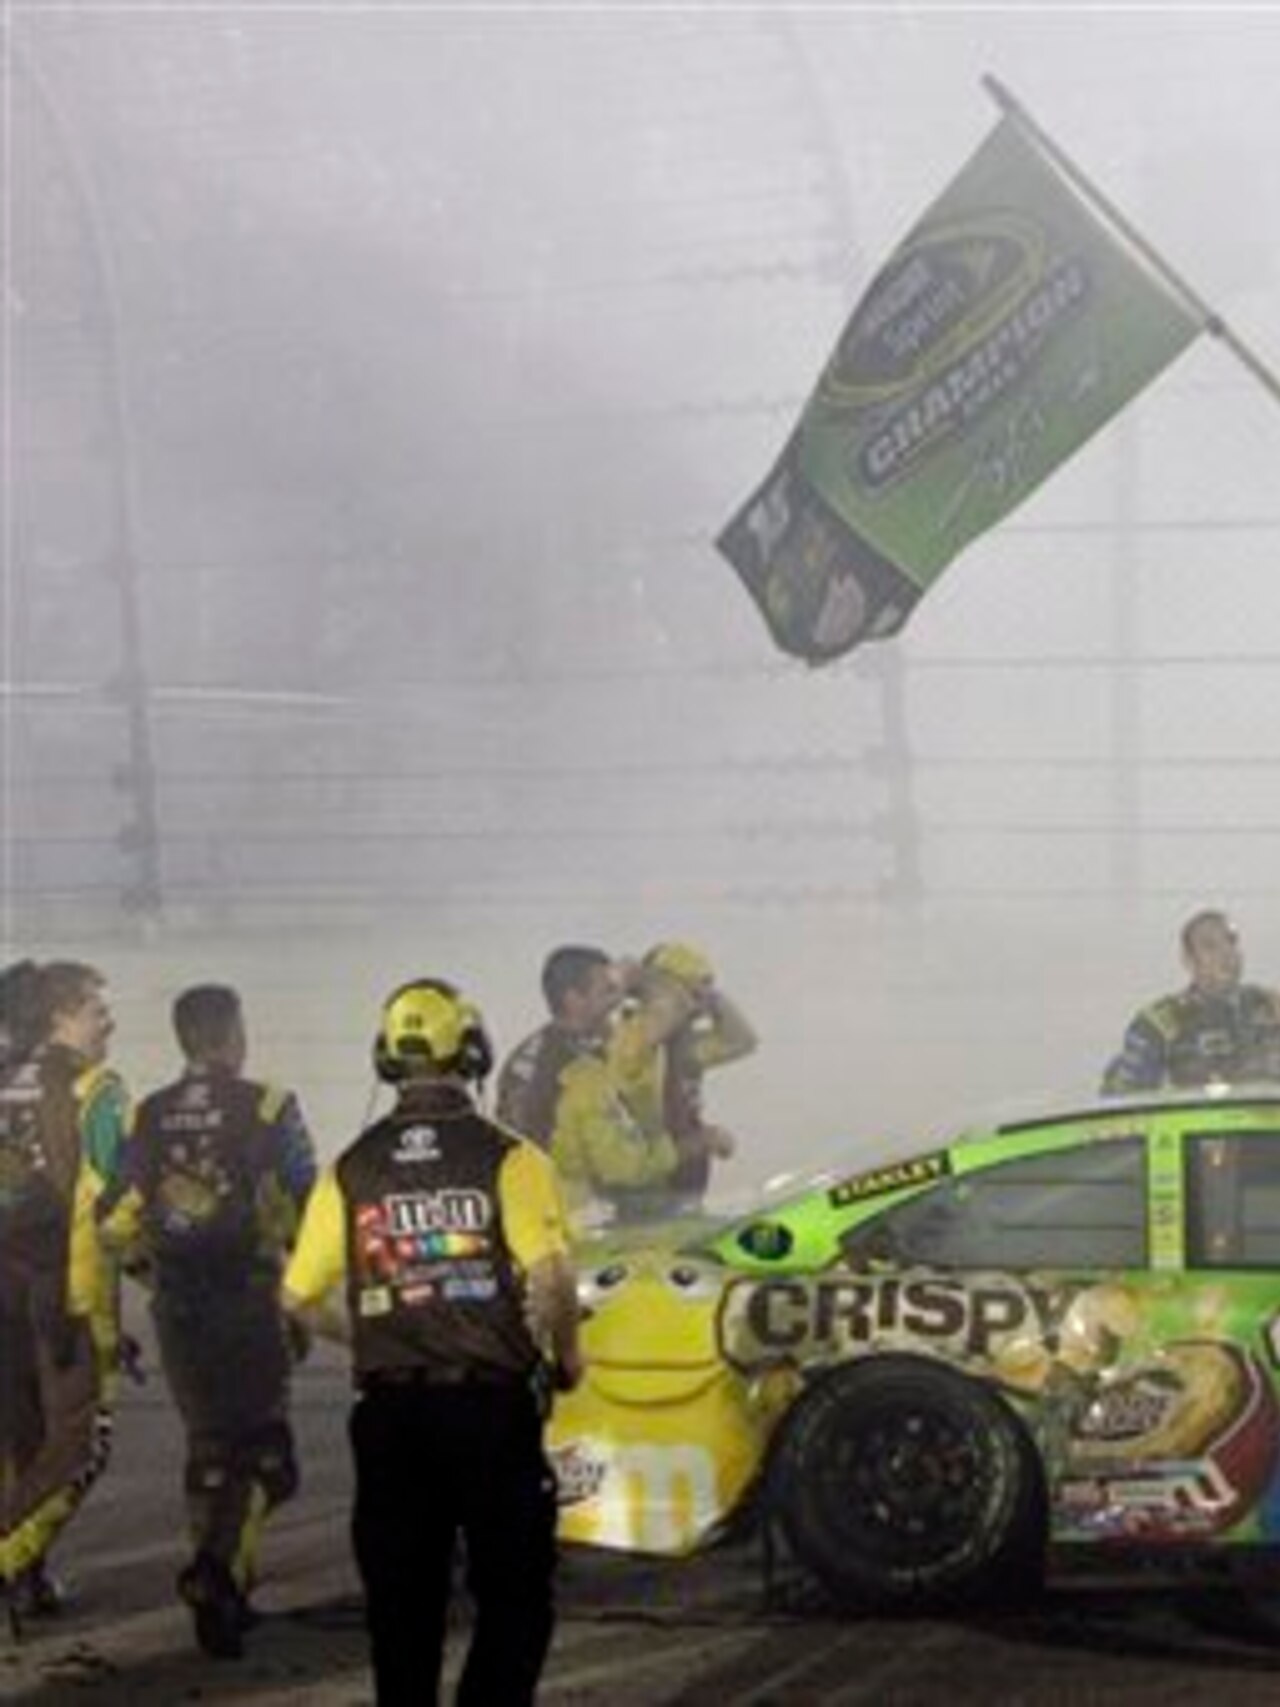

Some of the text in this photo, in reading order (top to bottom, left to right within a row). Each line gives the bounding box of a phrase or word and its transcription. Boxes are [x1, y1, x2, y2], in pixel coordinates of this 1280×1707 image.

[864, 252, 1088, 480] CHAMPION
[836, 1155, 942, 1202] STANLEY
[746, 1277, 1078, 1355] CRISPY
